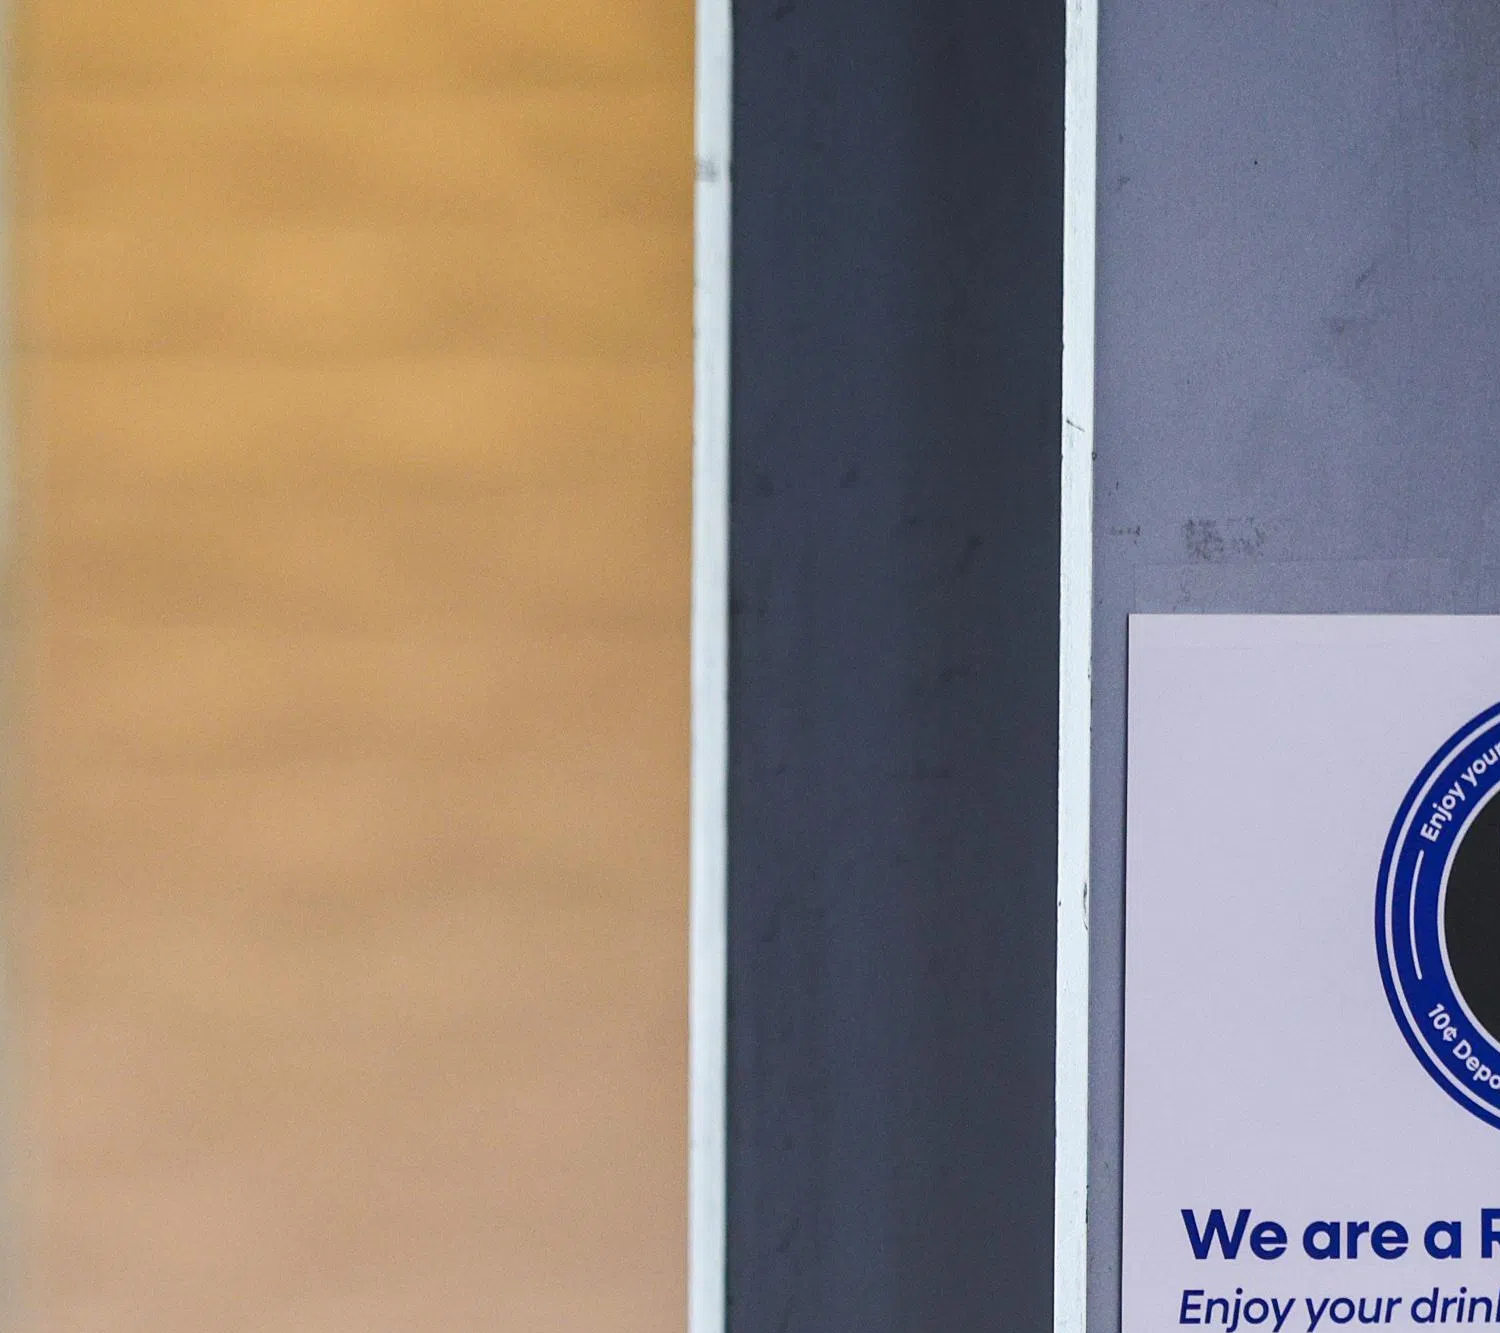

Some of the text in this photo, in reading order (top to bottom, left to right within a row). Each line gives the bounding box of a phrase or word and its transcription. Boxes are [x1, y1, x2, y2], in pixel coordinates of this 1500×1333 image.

[1420, 780, 1466, 842] Enjoy
[1428, 1003, 1458, 1042] 10¢
[1181, 1209, 1287, 1260] We
[1303, 1221, 1408, 1260] are
[1424, 1221, 1461, 1259] a
[1180, 1288, 1295, 1333] Enjoy
[1306, 1297, 1402, 1333] your
